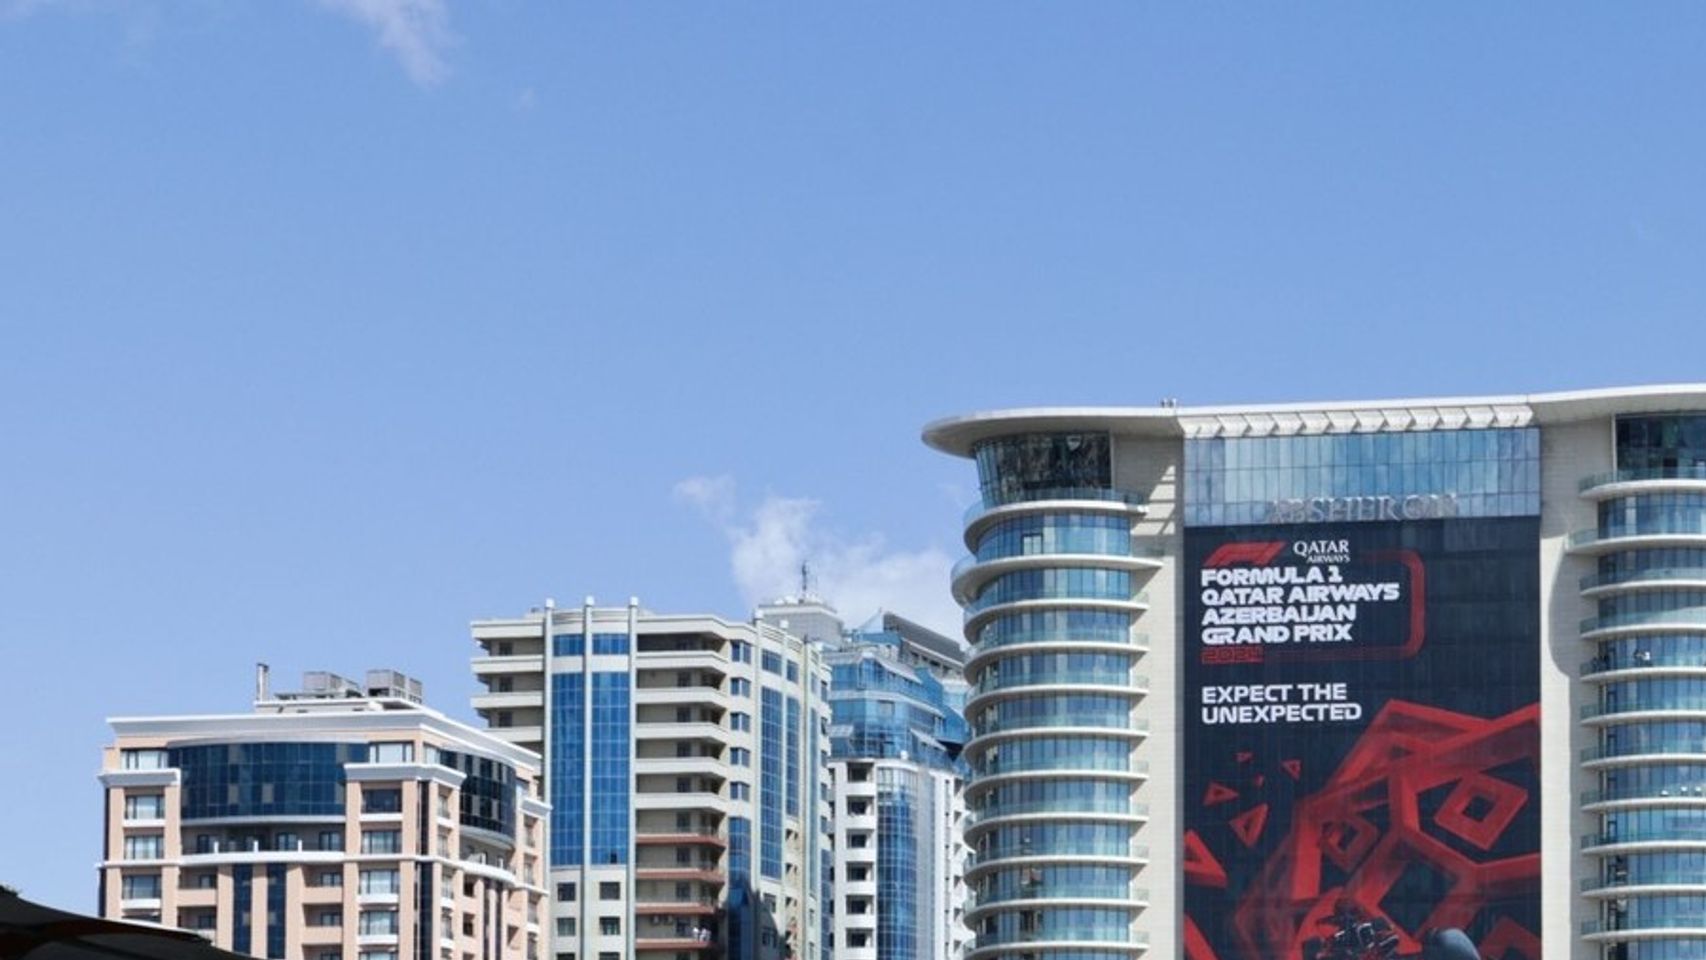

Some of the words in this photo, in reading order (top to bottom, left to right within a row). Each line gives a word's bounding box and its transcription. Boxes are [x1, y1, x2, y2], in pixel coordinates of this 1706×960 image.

[1294, 540, 1349, 556] QATAR
[1306, 554, 1351, 564] AIRWAYS
[1201, 566, 1324, 587] FORMULA
[1328, 565, 1343, 583] 1
[1201, 587, 1284, 606] QATAR
[1289, 582, 1400, 602] AIRWAYS
[1201, 604, 1356, 626] AZERBAIJAN
[1201, 625, 1290, 645] GRAND
[1294, 623, 1353, 643] PRIX
[1201, 685, 1293, 704] EXPECT
[1297, 682, 1347, 702] THE
[1201, 703, 1362, 725] UNEXPECTED
